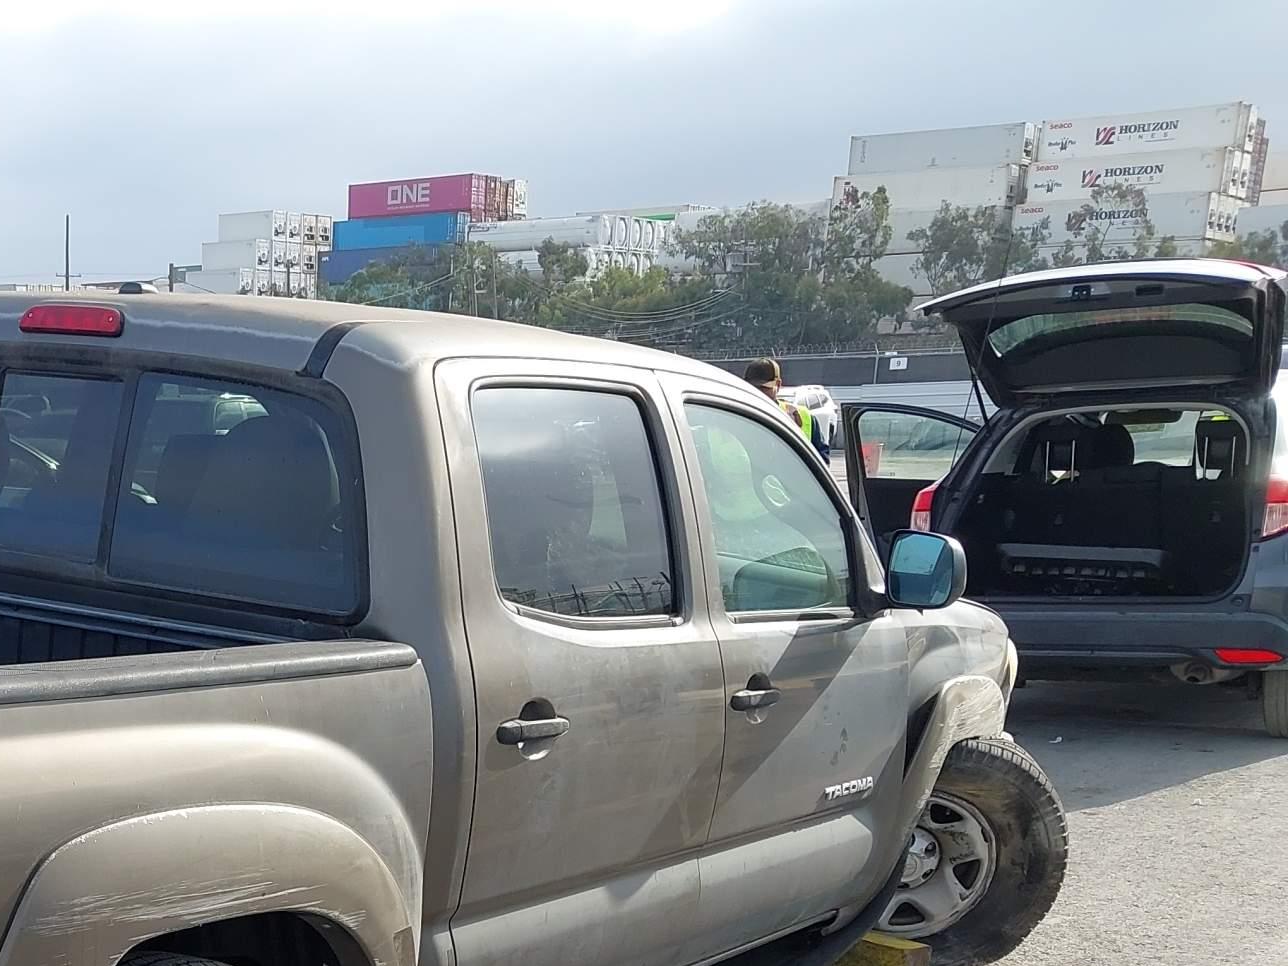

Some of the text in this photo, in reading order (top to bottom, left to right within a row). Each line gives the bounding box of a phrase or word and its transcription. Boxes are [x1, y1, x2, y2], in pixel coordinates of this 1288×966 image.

[1049, 122, 1073, 130] seaco
[1118, 120, 1180, 135] HORIZON
[1116, 132, 1169, 142] LINES
[1035, 164, 1059, 172] seaco
[1103, 164, 1165, 178] HORIZON
[387, 183, 431, 205] ONE
[824, 776, 874, 800] TACOMA
